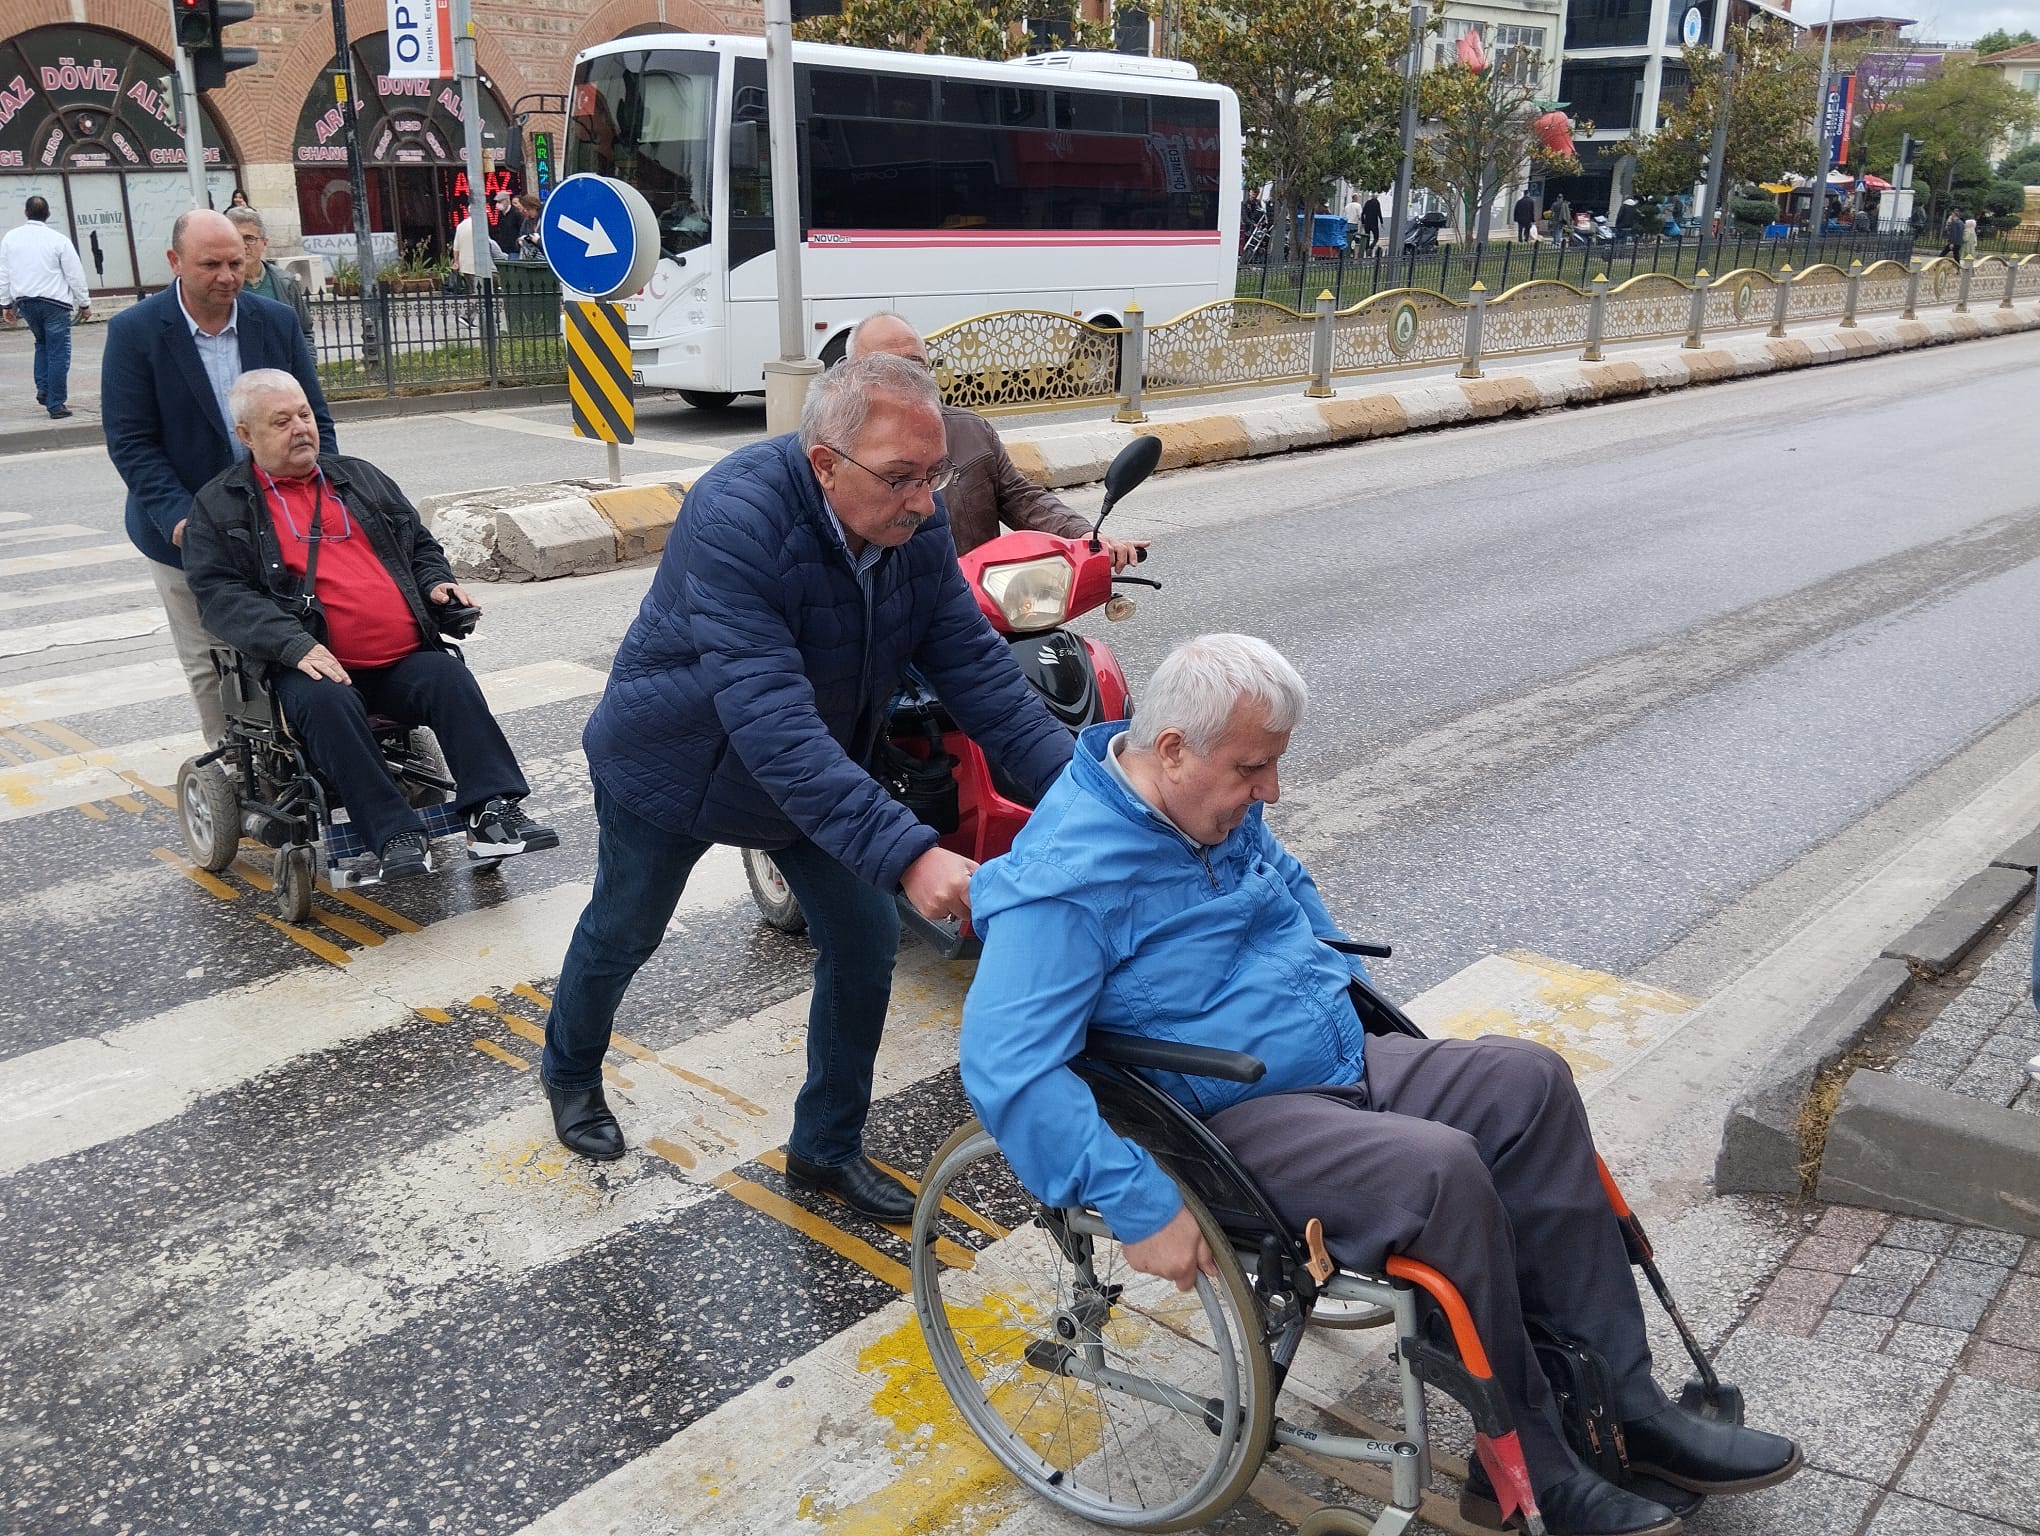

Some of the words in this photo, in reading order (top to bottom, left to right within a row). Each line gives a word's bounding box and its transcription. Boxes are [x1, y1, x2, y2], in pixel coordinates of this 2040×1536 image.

[395, 0, 420, 63] OP
[40, 57, 119, 92] DÖVİZ
[394, 120, 422, 131] USD
[41, 128, 64, 166] EURO
[112, 132, 139, 164] GBP
[150, 147, 221, 164] CHAGE
[454, 170, 512, 197] AAZ
